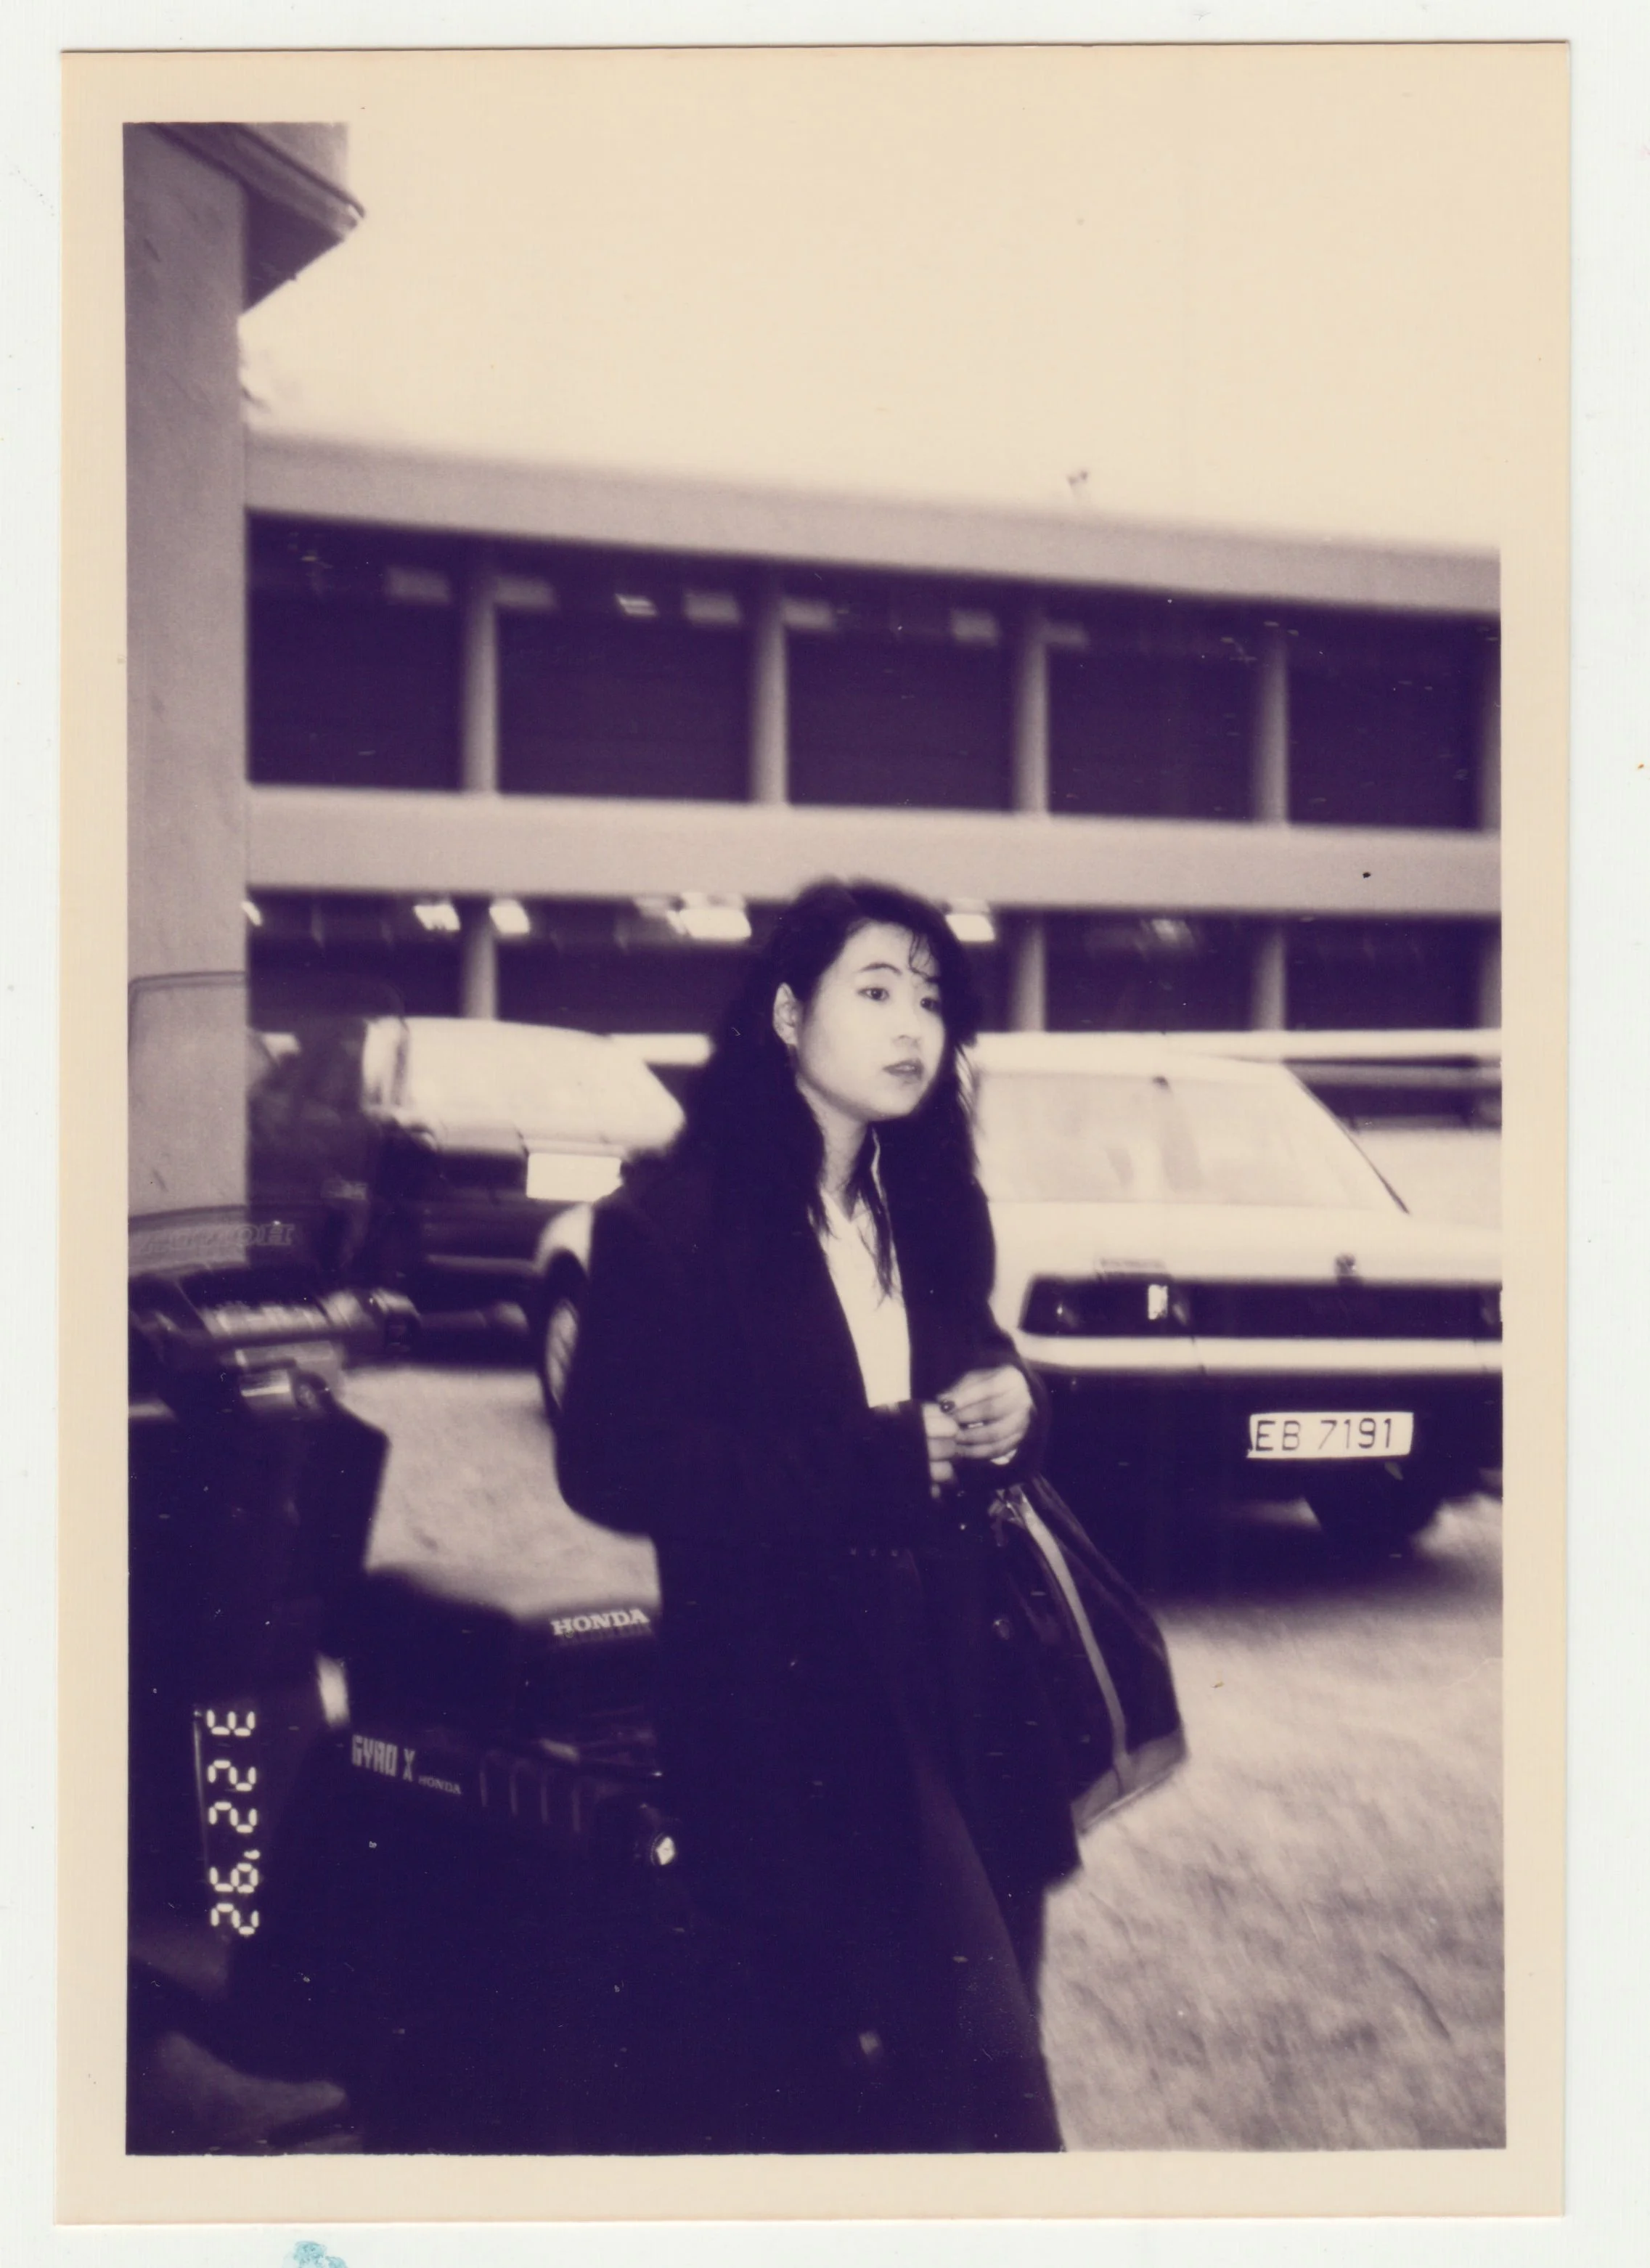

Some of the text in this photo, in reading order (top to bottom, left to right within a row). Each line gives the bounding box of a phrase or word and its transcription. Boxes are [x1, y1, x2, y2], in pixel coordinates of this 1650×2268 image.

[1255, 1417, 1392, 1451] EB 7191
[550, 1608, 650, 1636] HONDA
[351, 1734, 462, 1795] GYRO X HONDA
